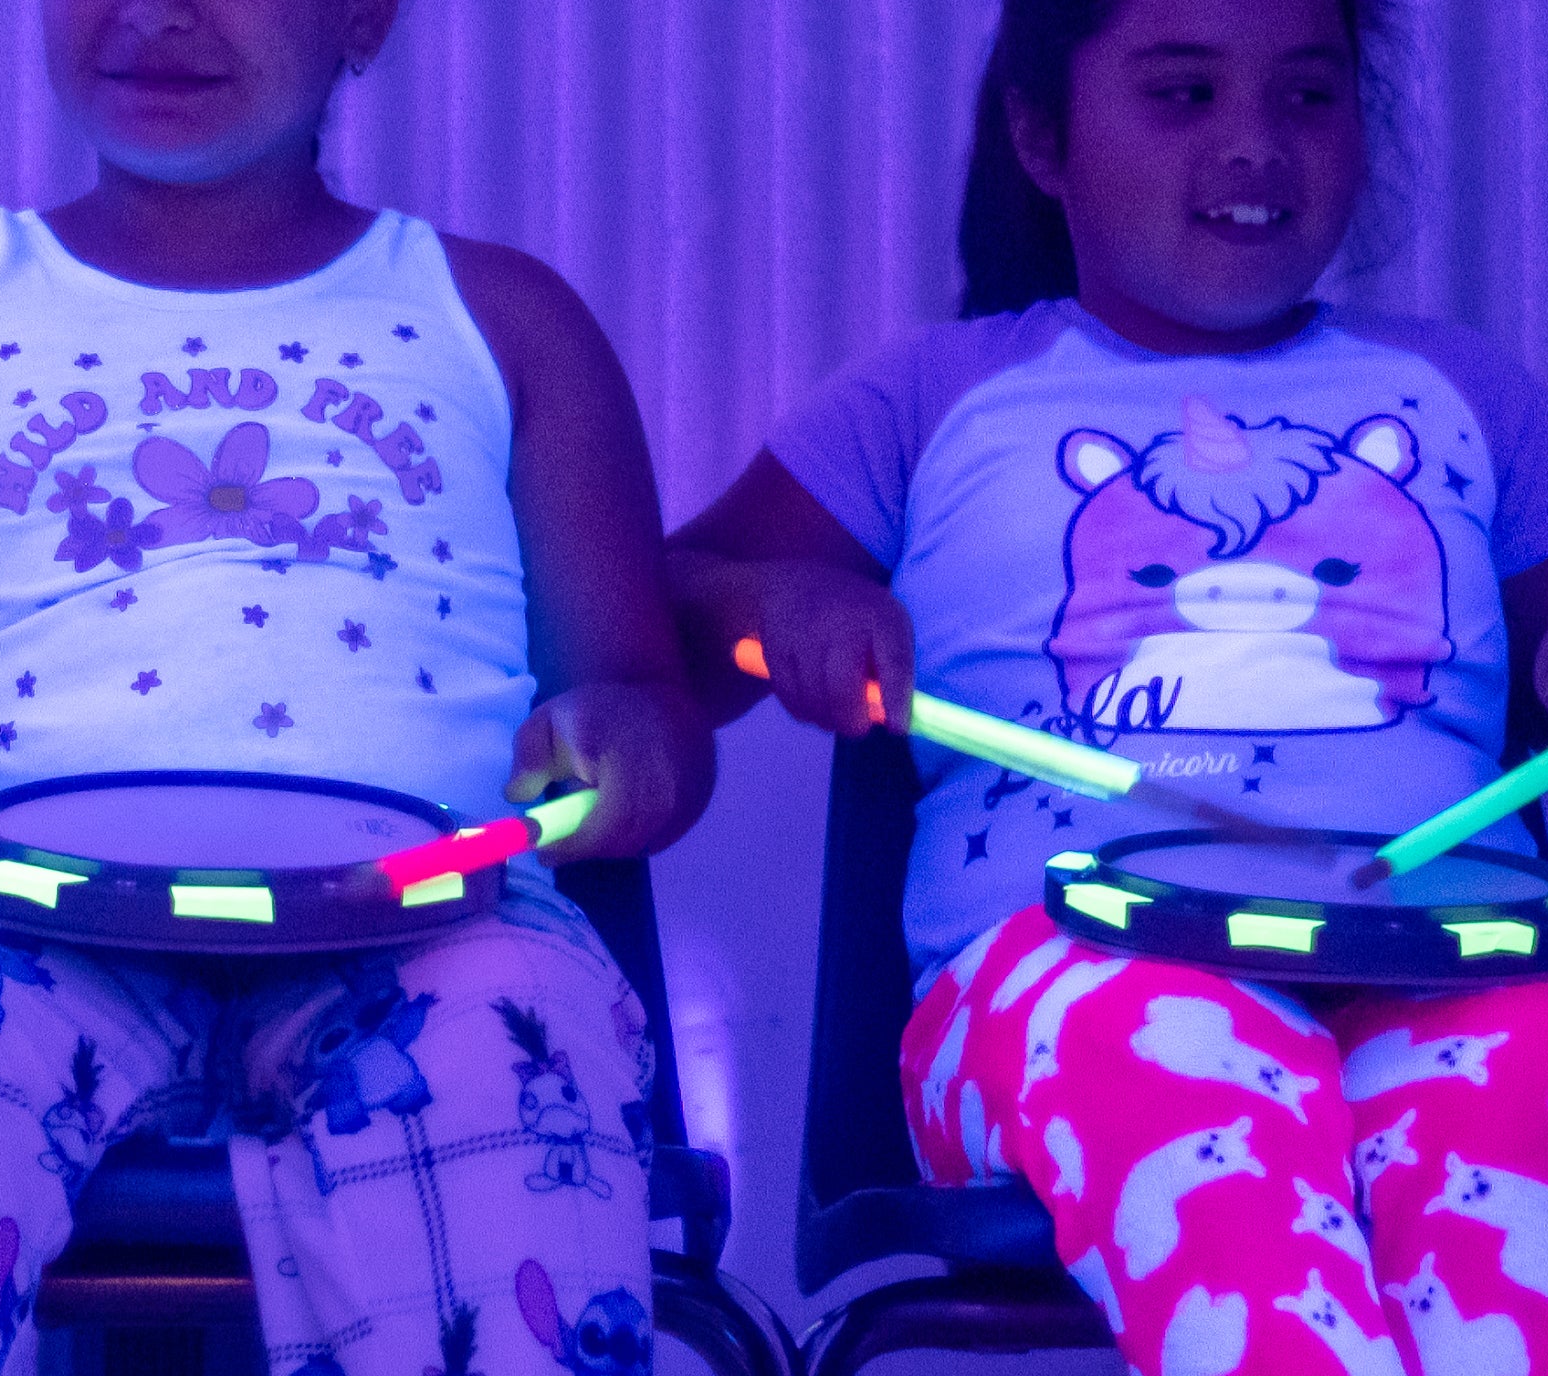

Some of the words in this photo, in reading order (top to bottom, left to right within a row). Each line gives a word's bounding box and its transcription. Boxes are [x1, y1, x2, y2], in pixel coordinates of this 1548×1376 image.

[140, 368, 279, 415] AND
[301, 378, 444, 506] FREE
[1140, 748, 1241, 778] nicorn
